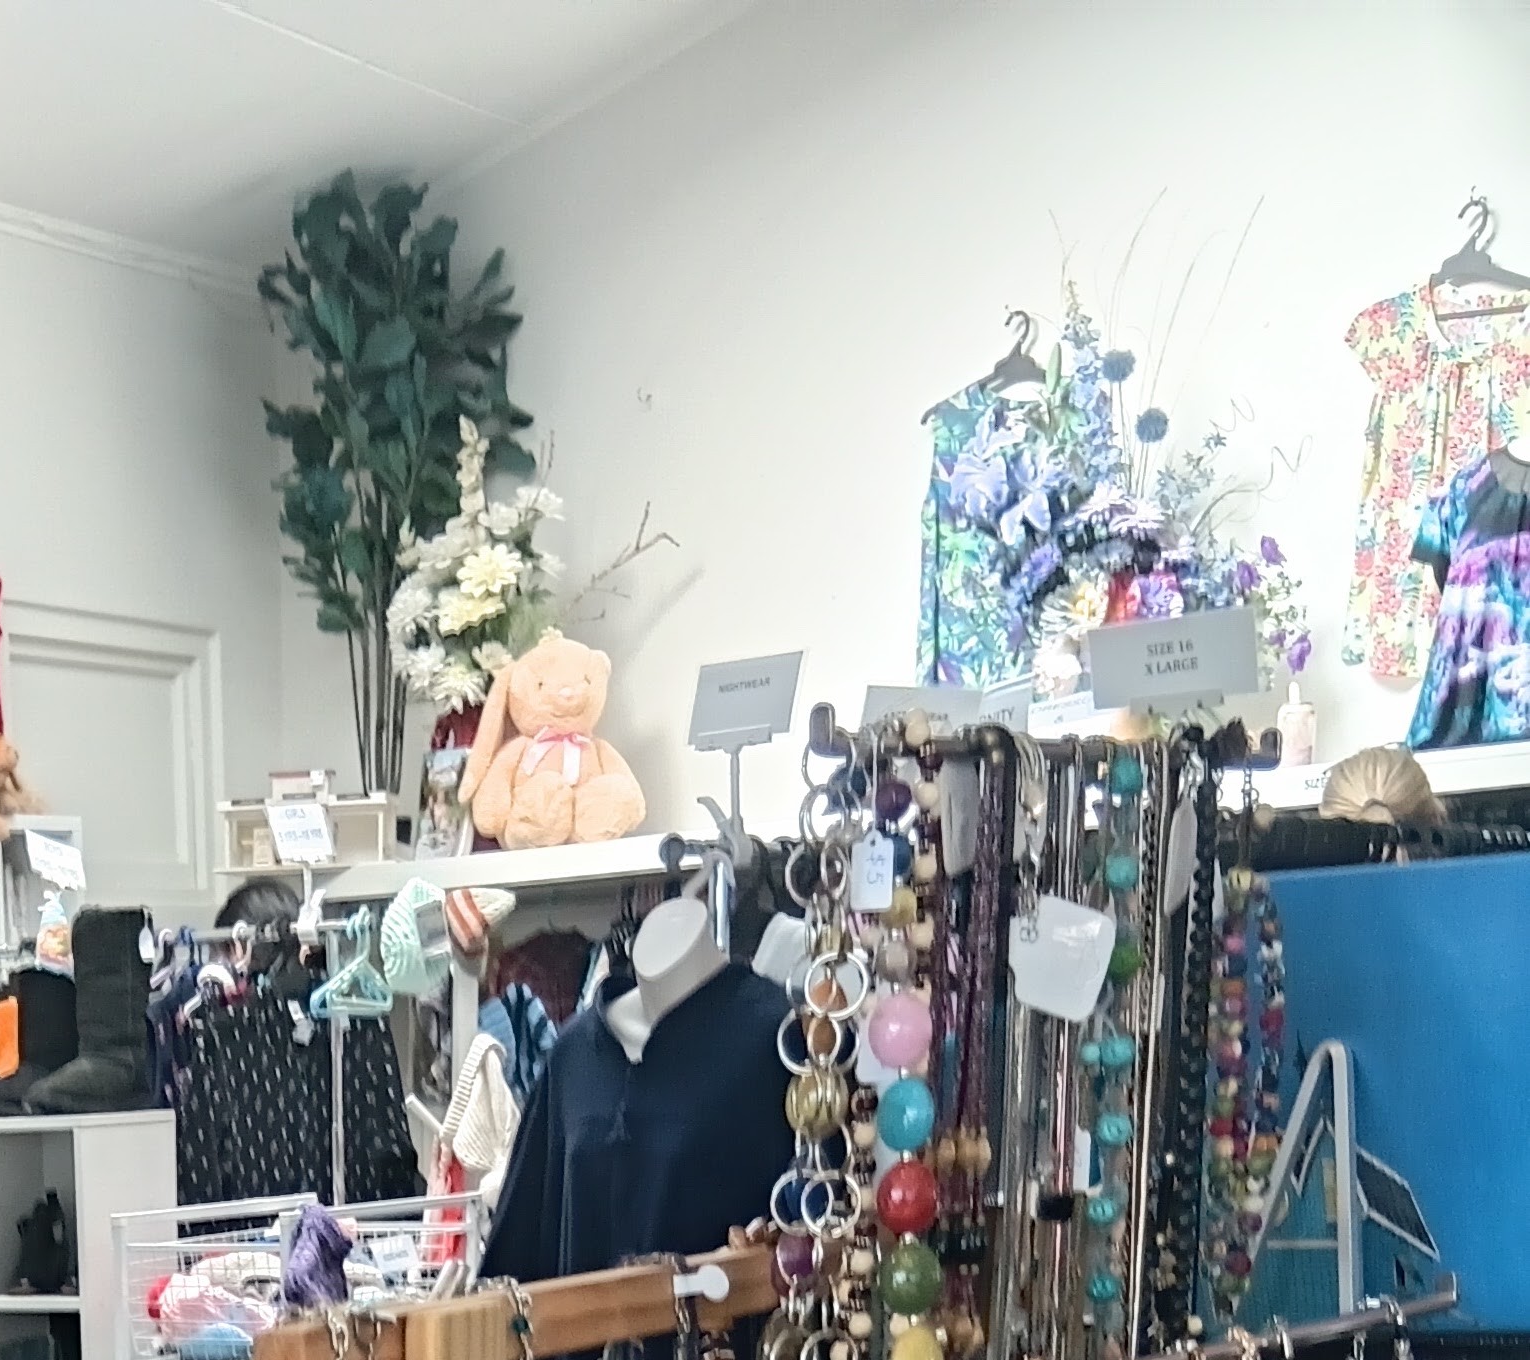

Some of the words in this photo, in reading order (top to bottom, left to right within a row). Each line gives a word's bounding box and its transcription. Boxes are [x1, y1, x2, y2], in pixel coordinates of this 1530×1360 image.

[1146, 642, 1175, 657] SIZE
[1178, 638, 1194, 653] 16
[1144, 663, 1154, 676] X
[1156, 657, 1199, 674] LARGE
